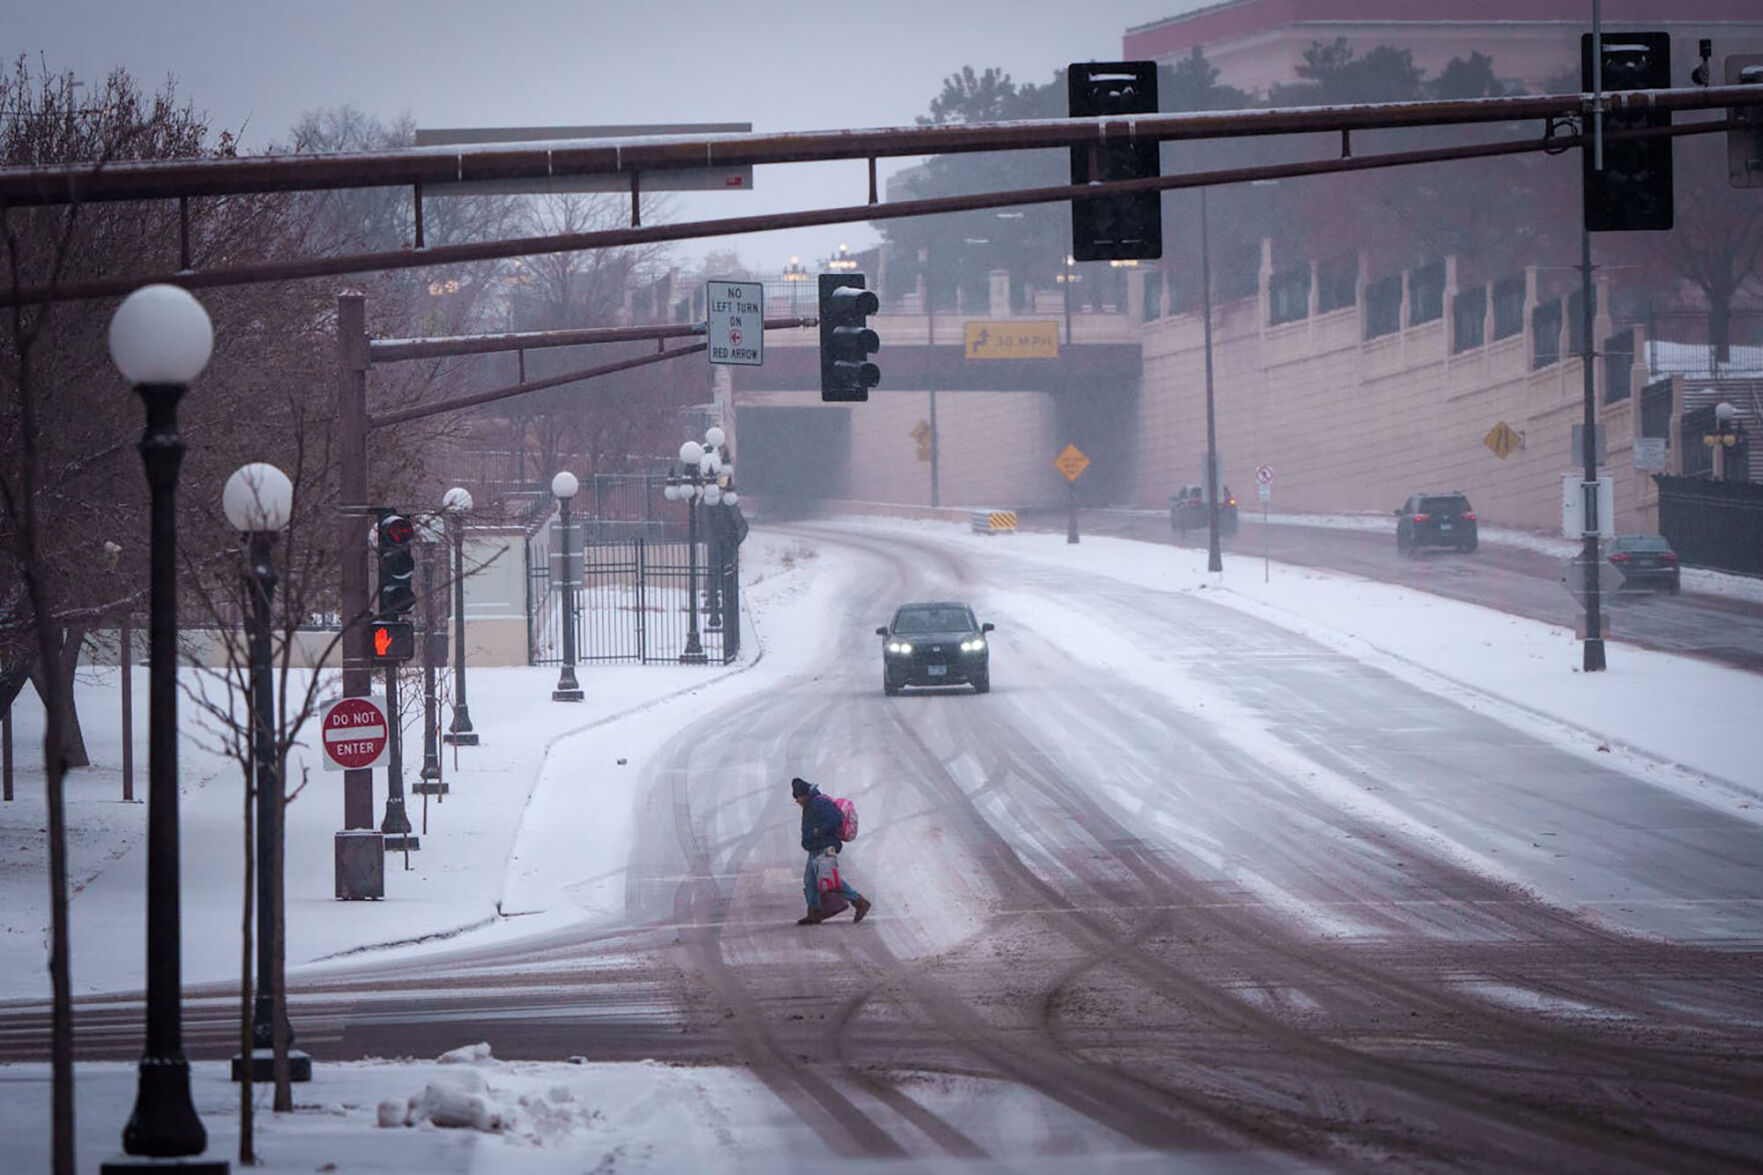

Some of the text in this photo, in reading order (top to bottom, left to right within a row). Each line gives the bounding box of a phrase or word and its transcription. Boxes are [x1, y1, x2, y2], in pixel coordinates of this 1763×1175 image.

[728, 288, 742, 298] NO
[712, 302, 758, 313] LEFT TURN
[730, 316, 742, 326] ON
[1019, 336, 1052, 346] MPH
[713, 347, 758, 360] RED ARROW
[333, 712, 376, 726] DO NOT
[337, 742, 374, 756] ENTER
